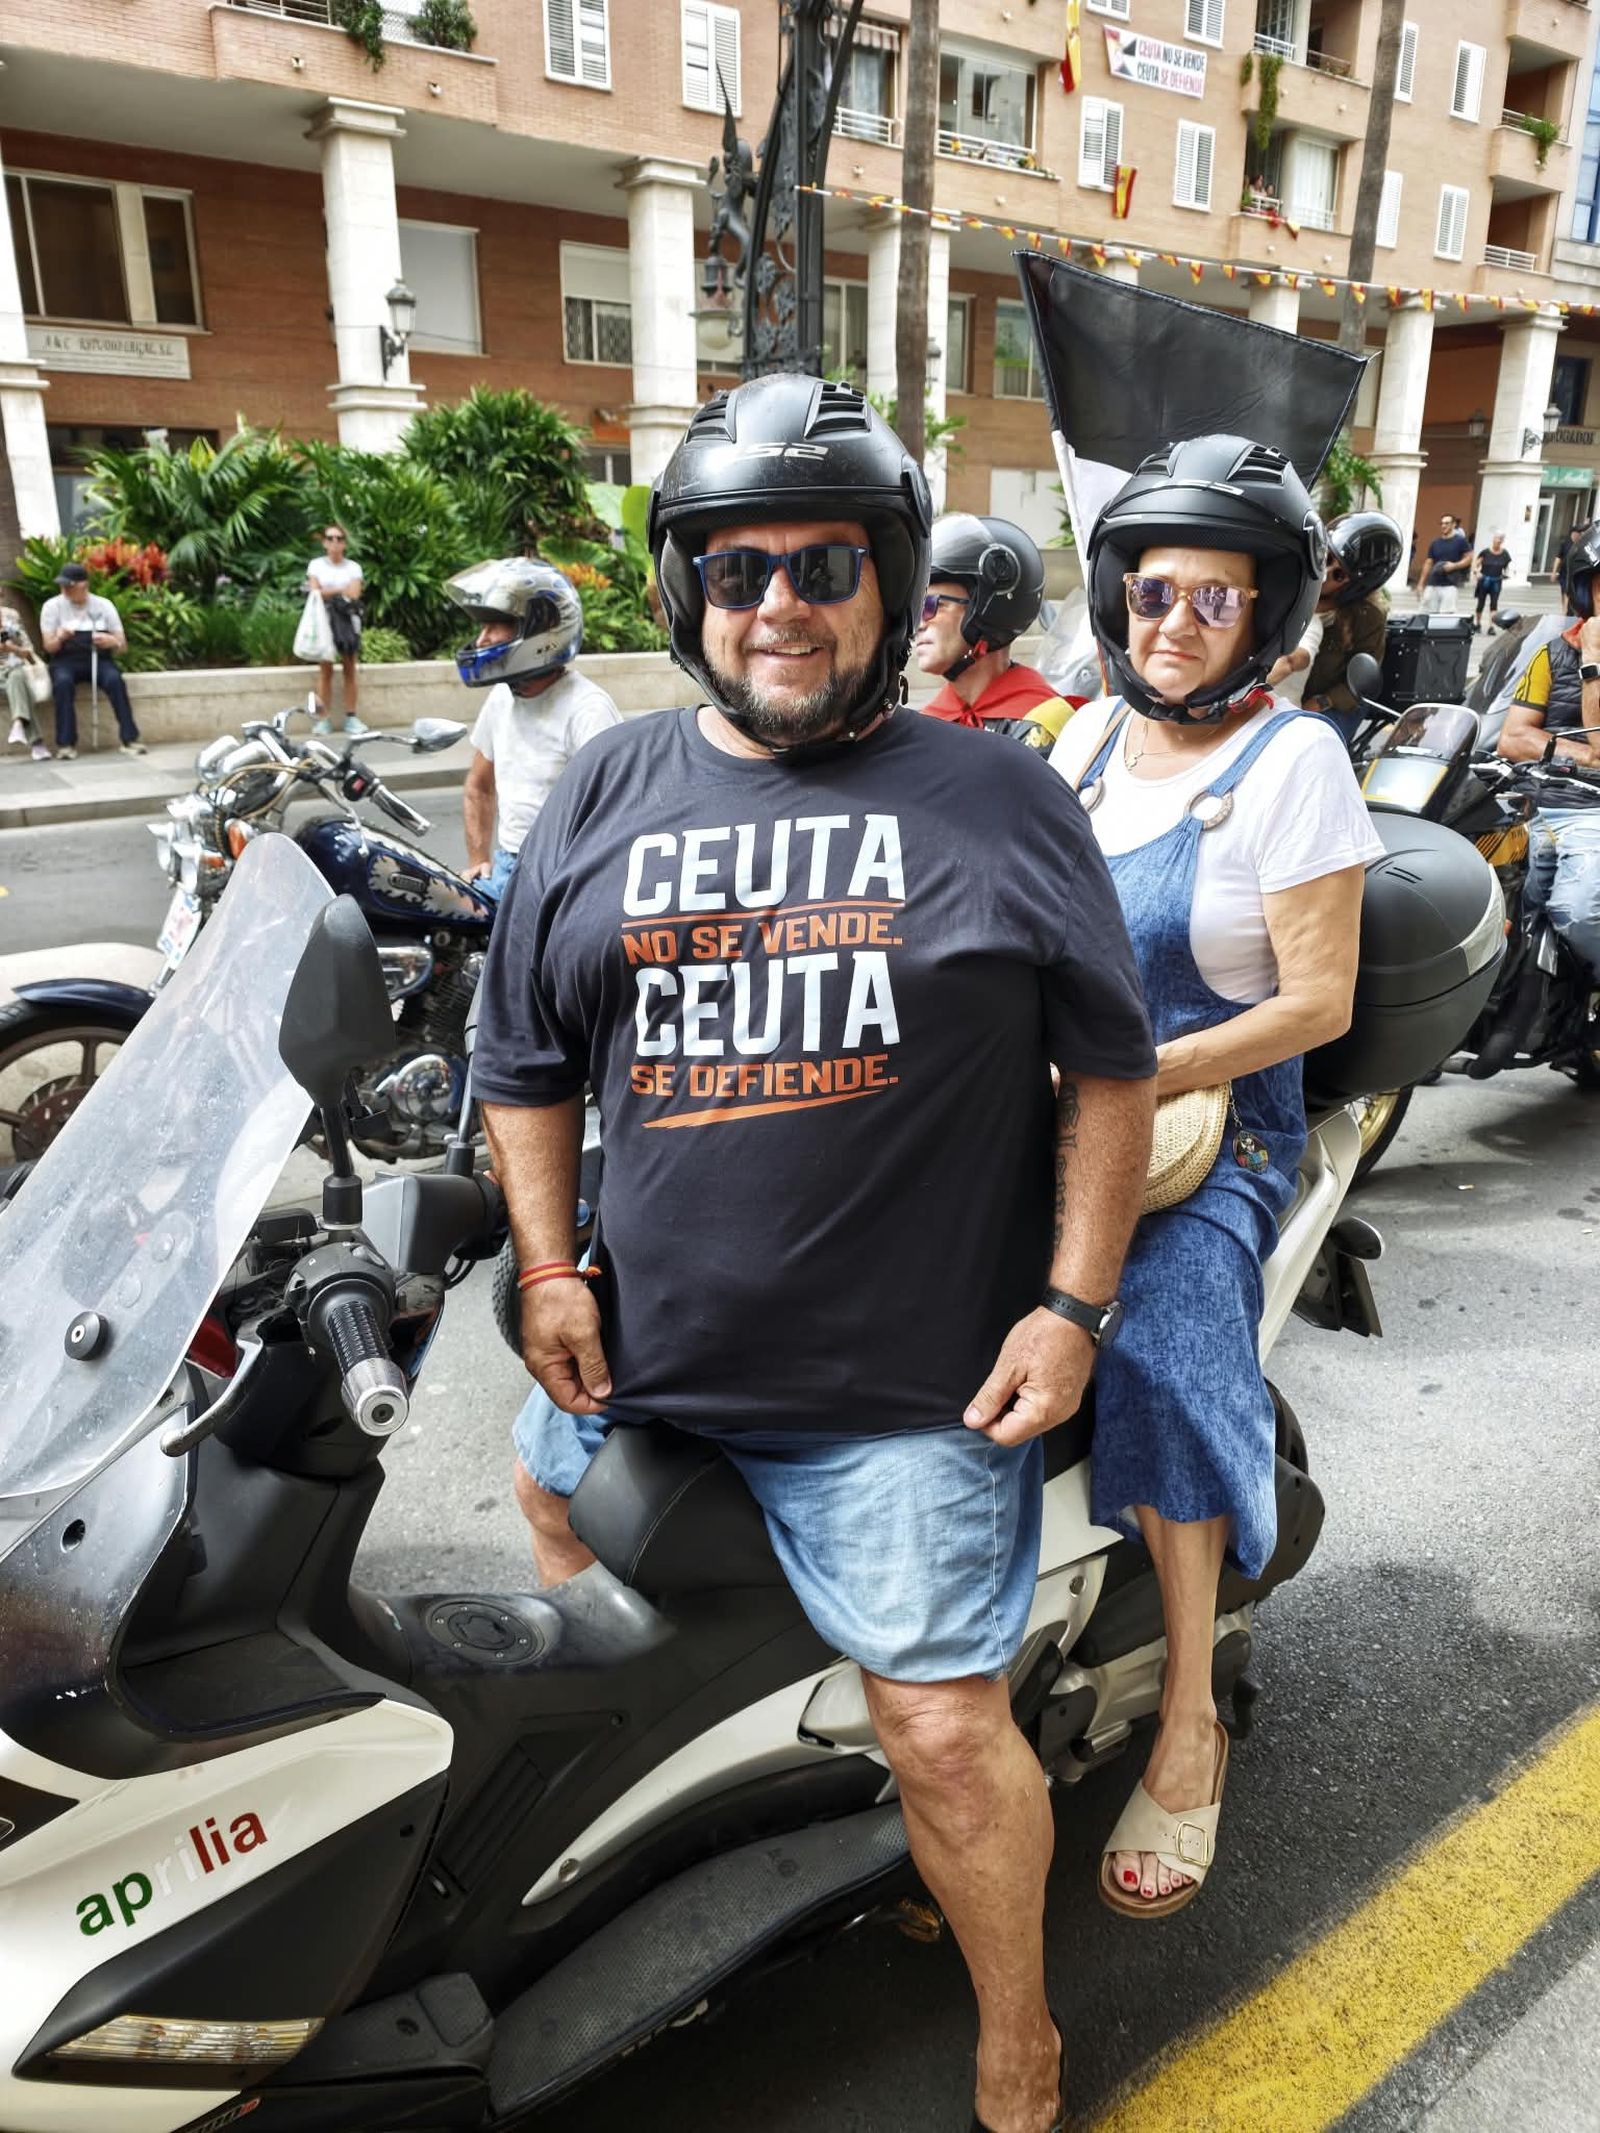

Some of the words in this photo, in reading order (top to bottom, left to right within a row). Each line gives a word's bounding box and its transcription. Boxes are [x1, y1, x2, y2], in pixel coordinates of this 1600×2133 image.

[1137, 62, 1159, 84] CEUTA
[1161, 68, 1169, 86] SE
[1139, 40, 1161, 61] CEUTA
[1163, 45, 1172, 64] NO
[1174, 48, 1182, 67] SE
[1183, 51, 1205, 73] VENDE
[623, 814, 905, 917] CEUTA
[621, 930, 677, 965] NO
[692, 925, 743, 960] SE
[758, 912, 903, 954] VENDE.
[635, 951, 900, 1056] CEUTA
[630, 1064, 675, 1096] SE
[689, 1054, 899, 1097] DEFIENDE.
[76, 1812, 268, 1936] aprilia
